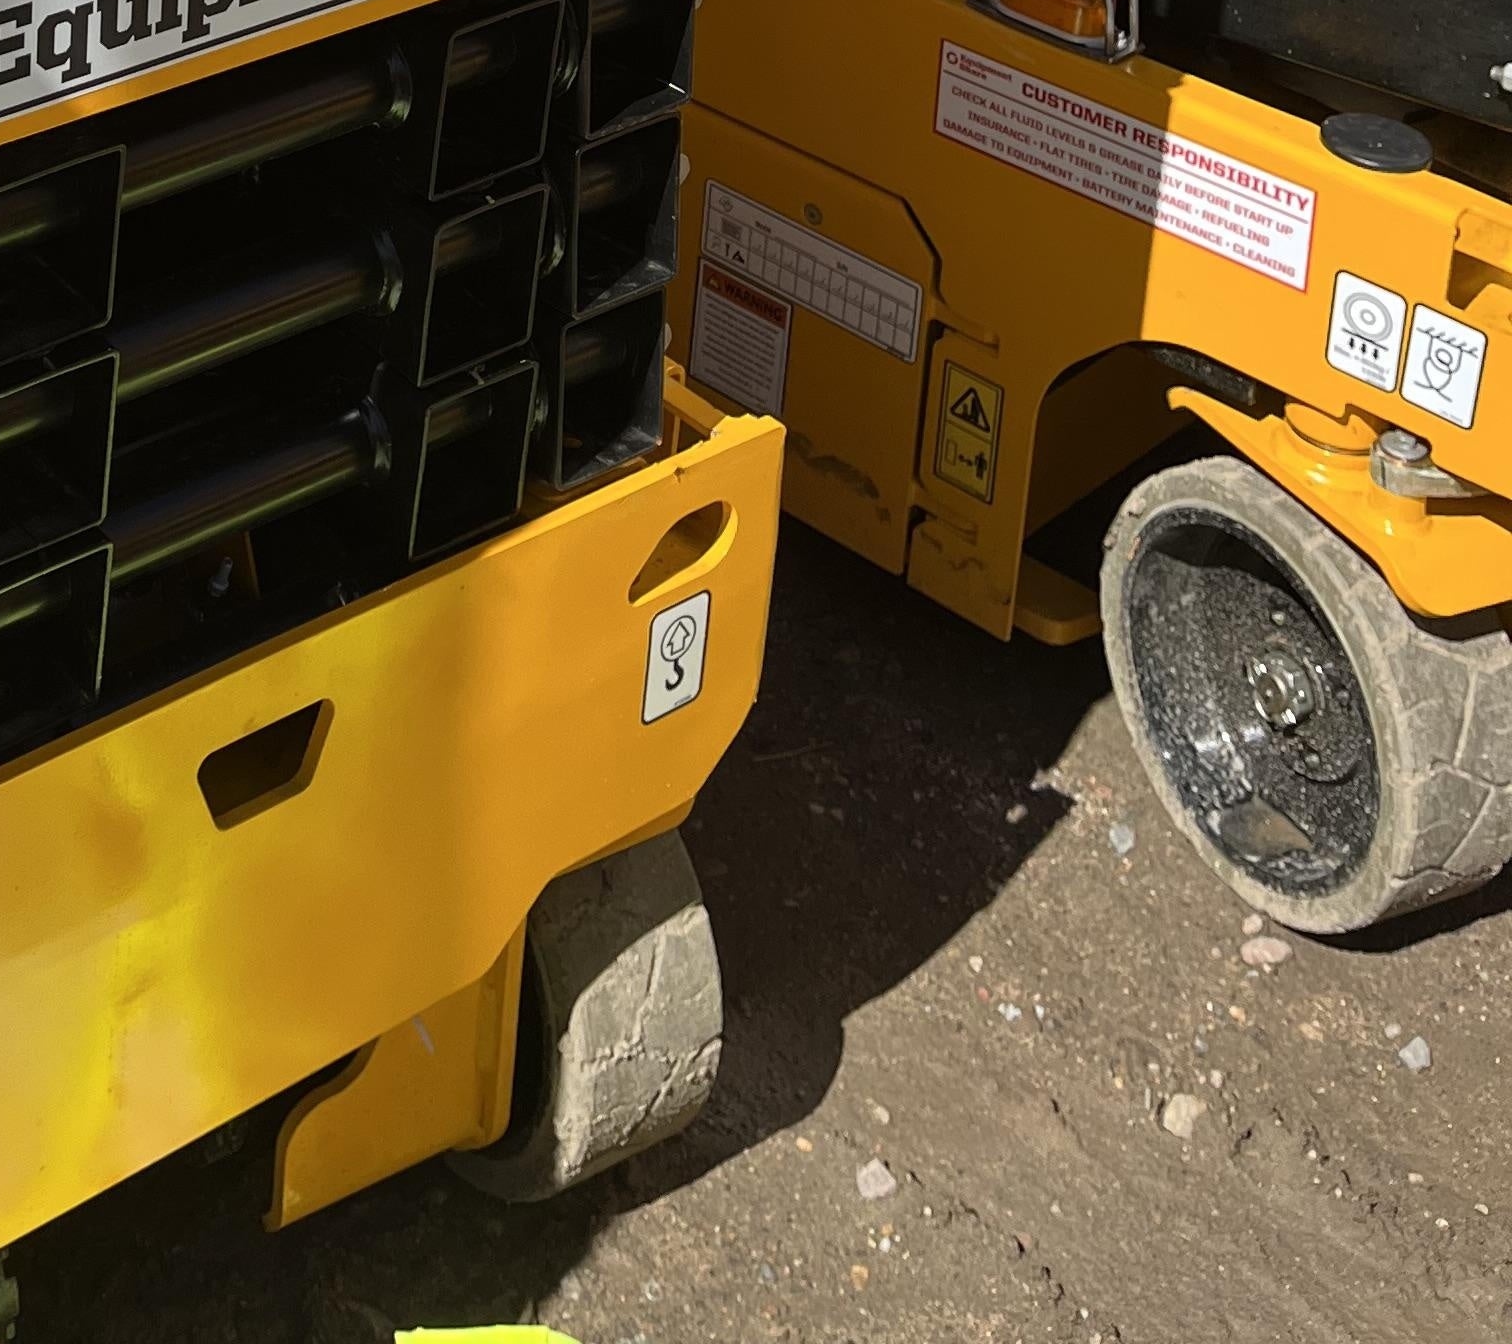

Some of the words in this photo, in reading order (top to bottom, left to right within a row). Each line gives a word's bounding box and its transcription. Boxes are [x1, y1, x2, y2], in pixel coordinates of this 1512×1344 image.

[942, 116, 987, 146] DAMAGE
[989, 137, 1004, 153] TO
[1006, 144, 1073, 183] EQUIPMENT
[1082, 176, 1133, 209] BATTERY
[1135, 199, 1223, 248] MAINTENANCE
[1232, 241, 1295, 280] CLEANING
[950, 83, 987, 108] CHECK
[988, 99, 1007, 117] ALL
[1009, 108, 1043, 132] FLUID
[1045, 123, 1085, 150] LEVELS
[1098, 146, 1144, 175] GREASE
[1146, 166, 1181, 191] DAILY
[1183, 182, 1231, 212] BEFORE
[1232, 202, 1272, 230] START
[1274, 220, 1294, 239] UP
[967, 108, 1031, 146] INSURANCE
[1039, 139, 1065, 160] FLAT
[1068, 152, 1102, 176] TIRES
[1110, 170, 1141, 193] TIRE
[1140, 183, 1192, 215] DAMAGE
[1200, 208, 1270, 248] REFUELING
[1020, 79, 1127, 138] CUSTOMER
[1132, 126, 1309, 214] RESPONSIBILITY
